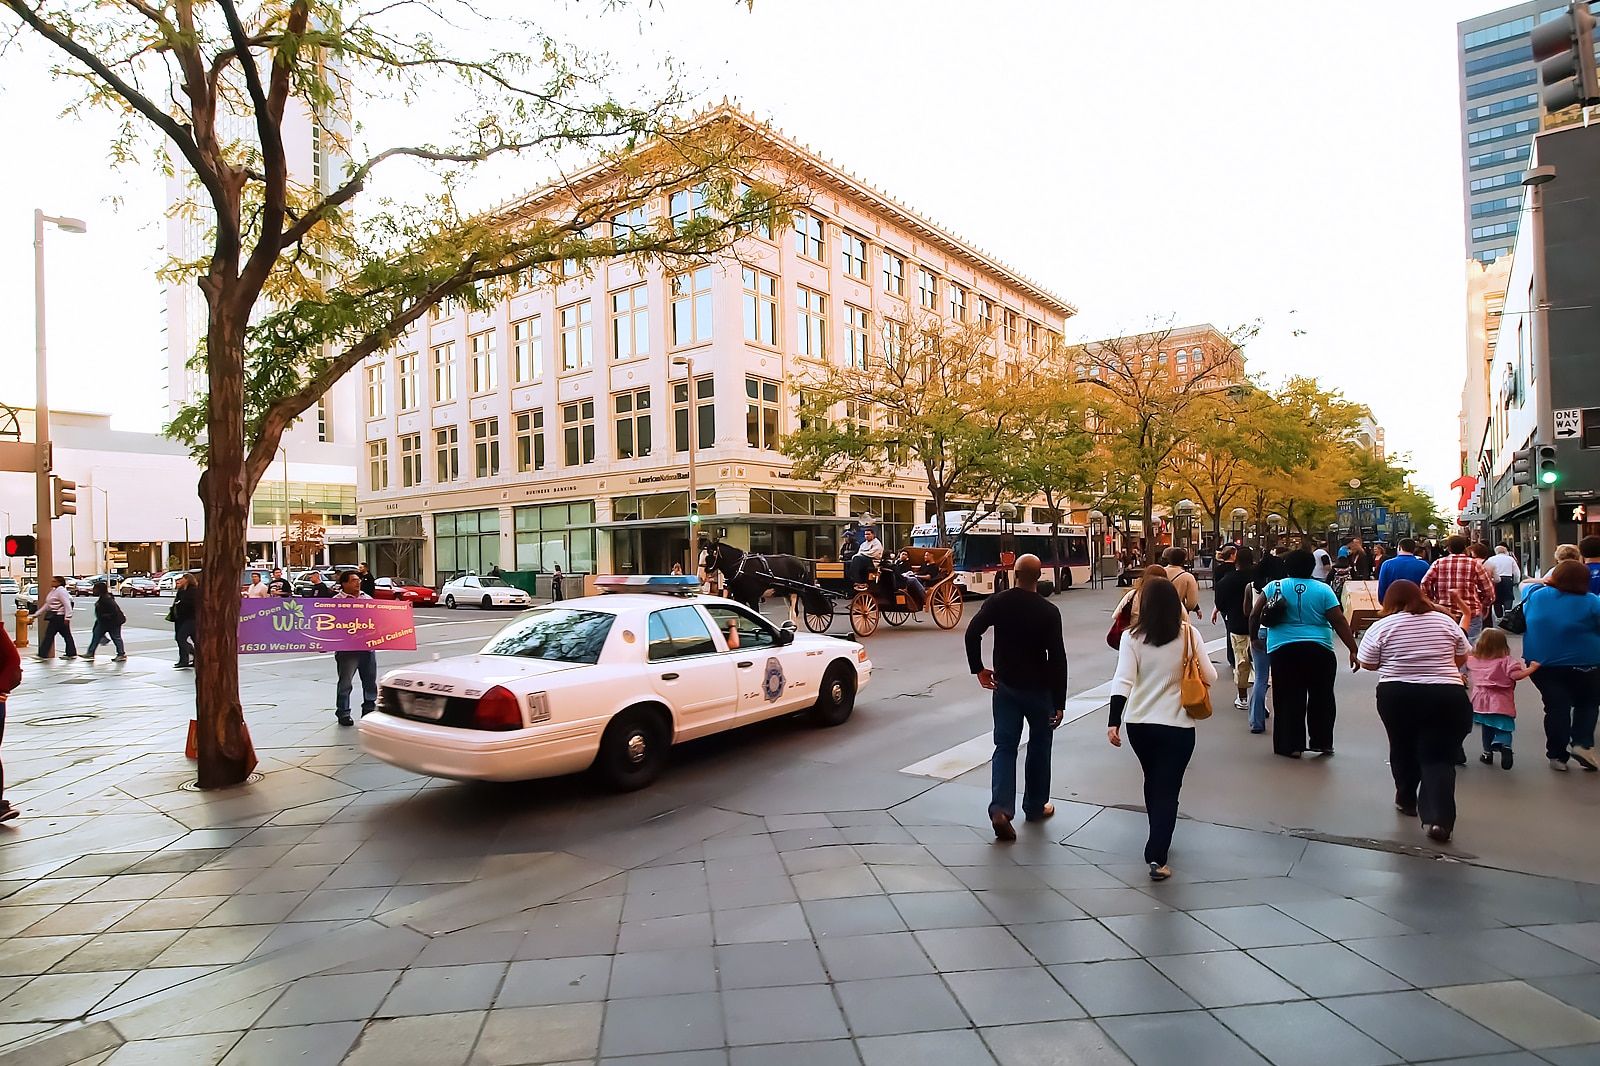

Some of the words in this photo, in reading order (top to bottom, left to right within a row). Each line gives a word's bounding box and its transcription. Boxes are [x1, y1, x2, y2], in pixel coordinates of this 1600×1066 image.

[1556, 411, 1578, 419] ONE
[1556, 420, 1579, 428] WAY
[258, 606, 281, 617] Open
[273, 613, 312, 632] Wild
[310, 614, 376, 635] Bangkok
[366, 636, 385, 648] Thai
[386, 628, 413, 641] Cuisine
[240, 643, 267, 652] 1630
[309, 642, 323, 650] St.
